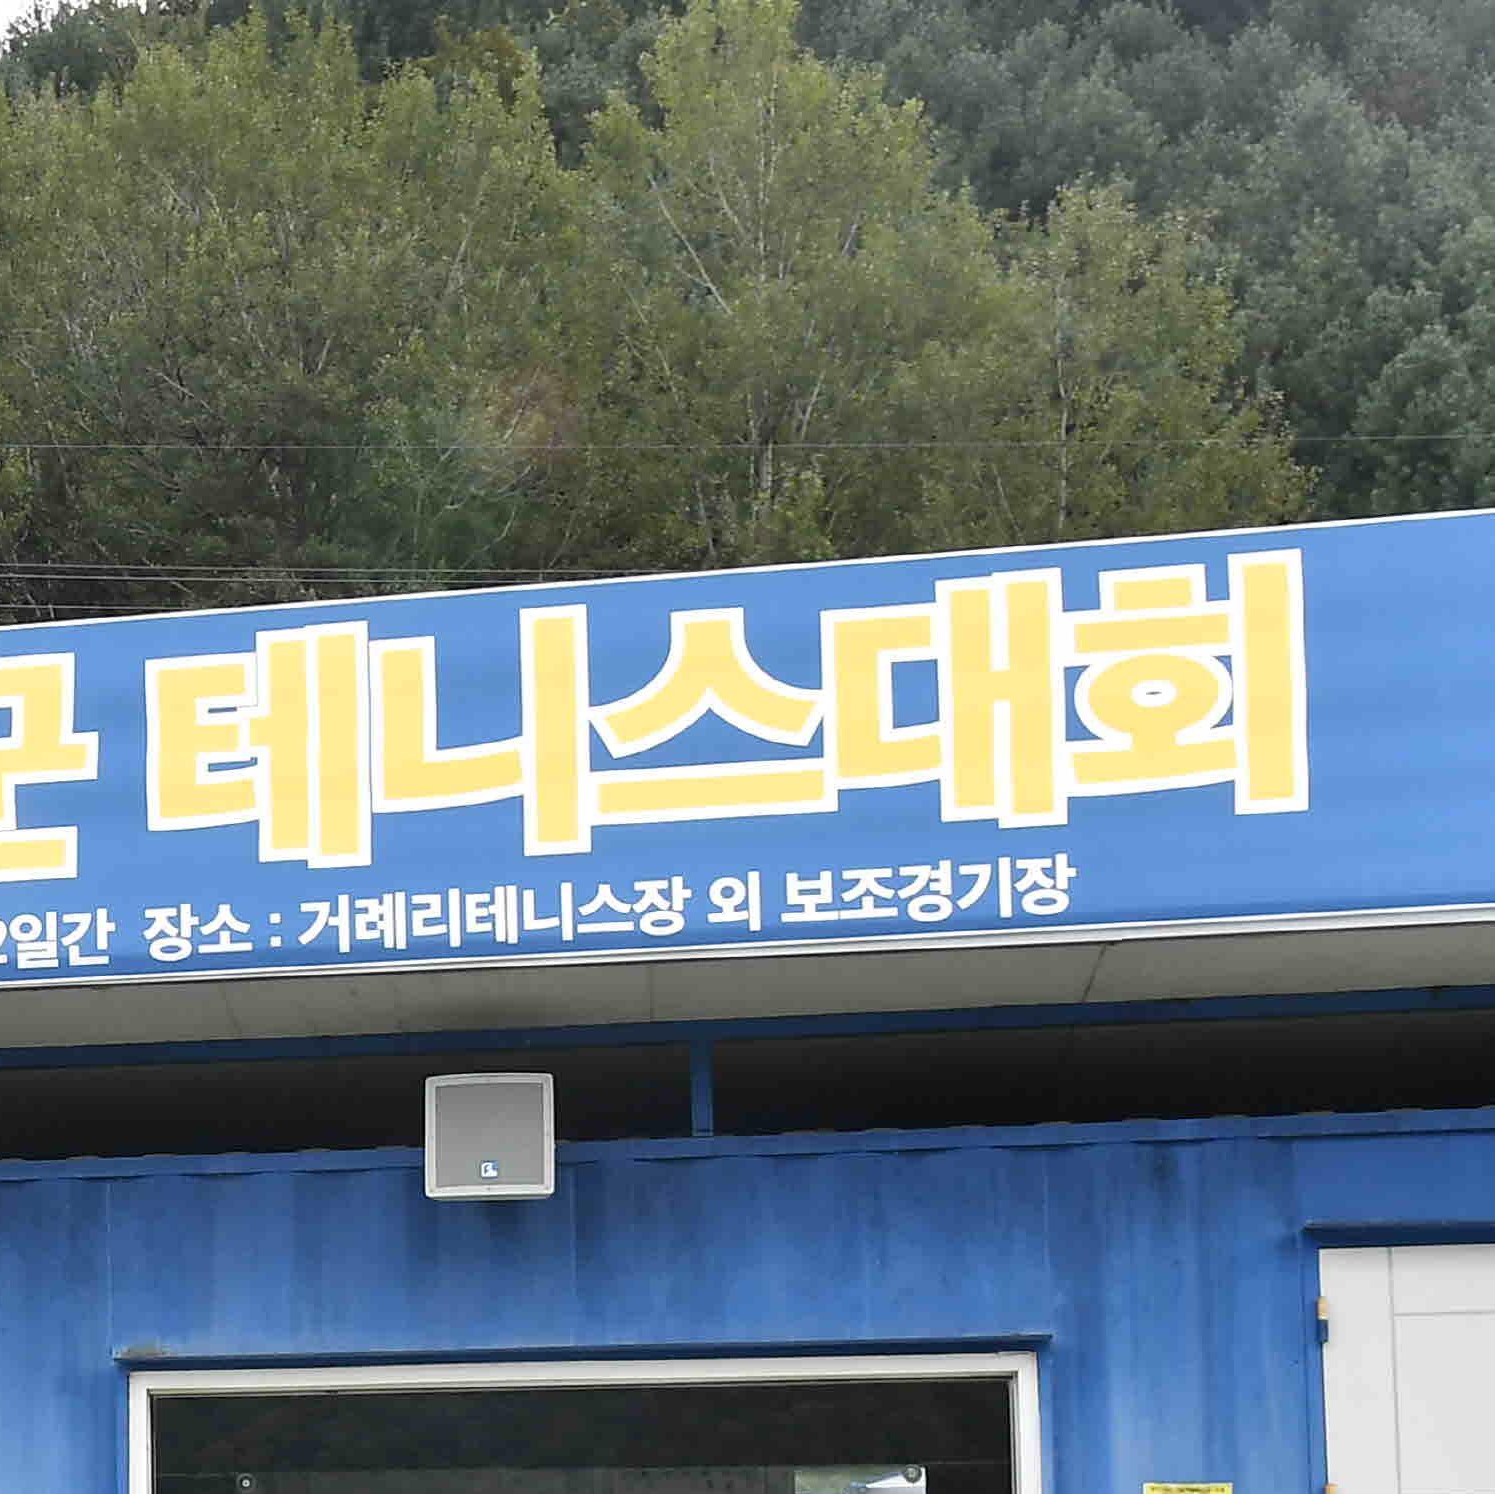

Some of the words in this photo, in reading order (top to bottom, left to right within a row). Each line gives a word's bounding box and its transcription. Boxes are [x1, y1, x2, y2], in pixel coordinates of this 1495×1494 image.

[144, 548, 1310, 868] 테니스대회
[142, 902, 253, 962] 장소
[297, 875, 692, 953] 거례리테니스장
[706, 870, 761, 932] 외
[779, 852, 1077, 923] 보조경기장
